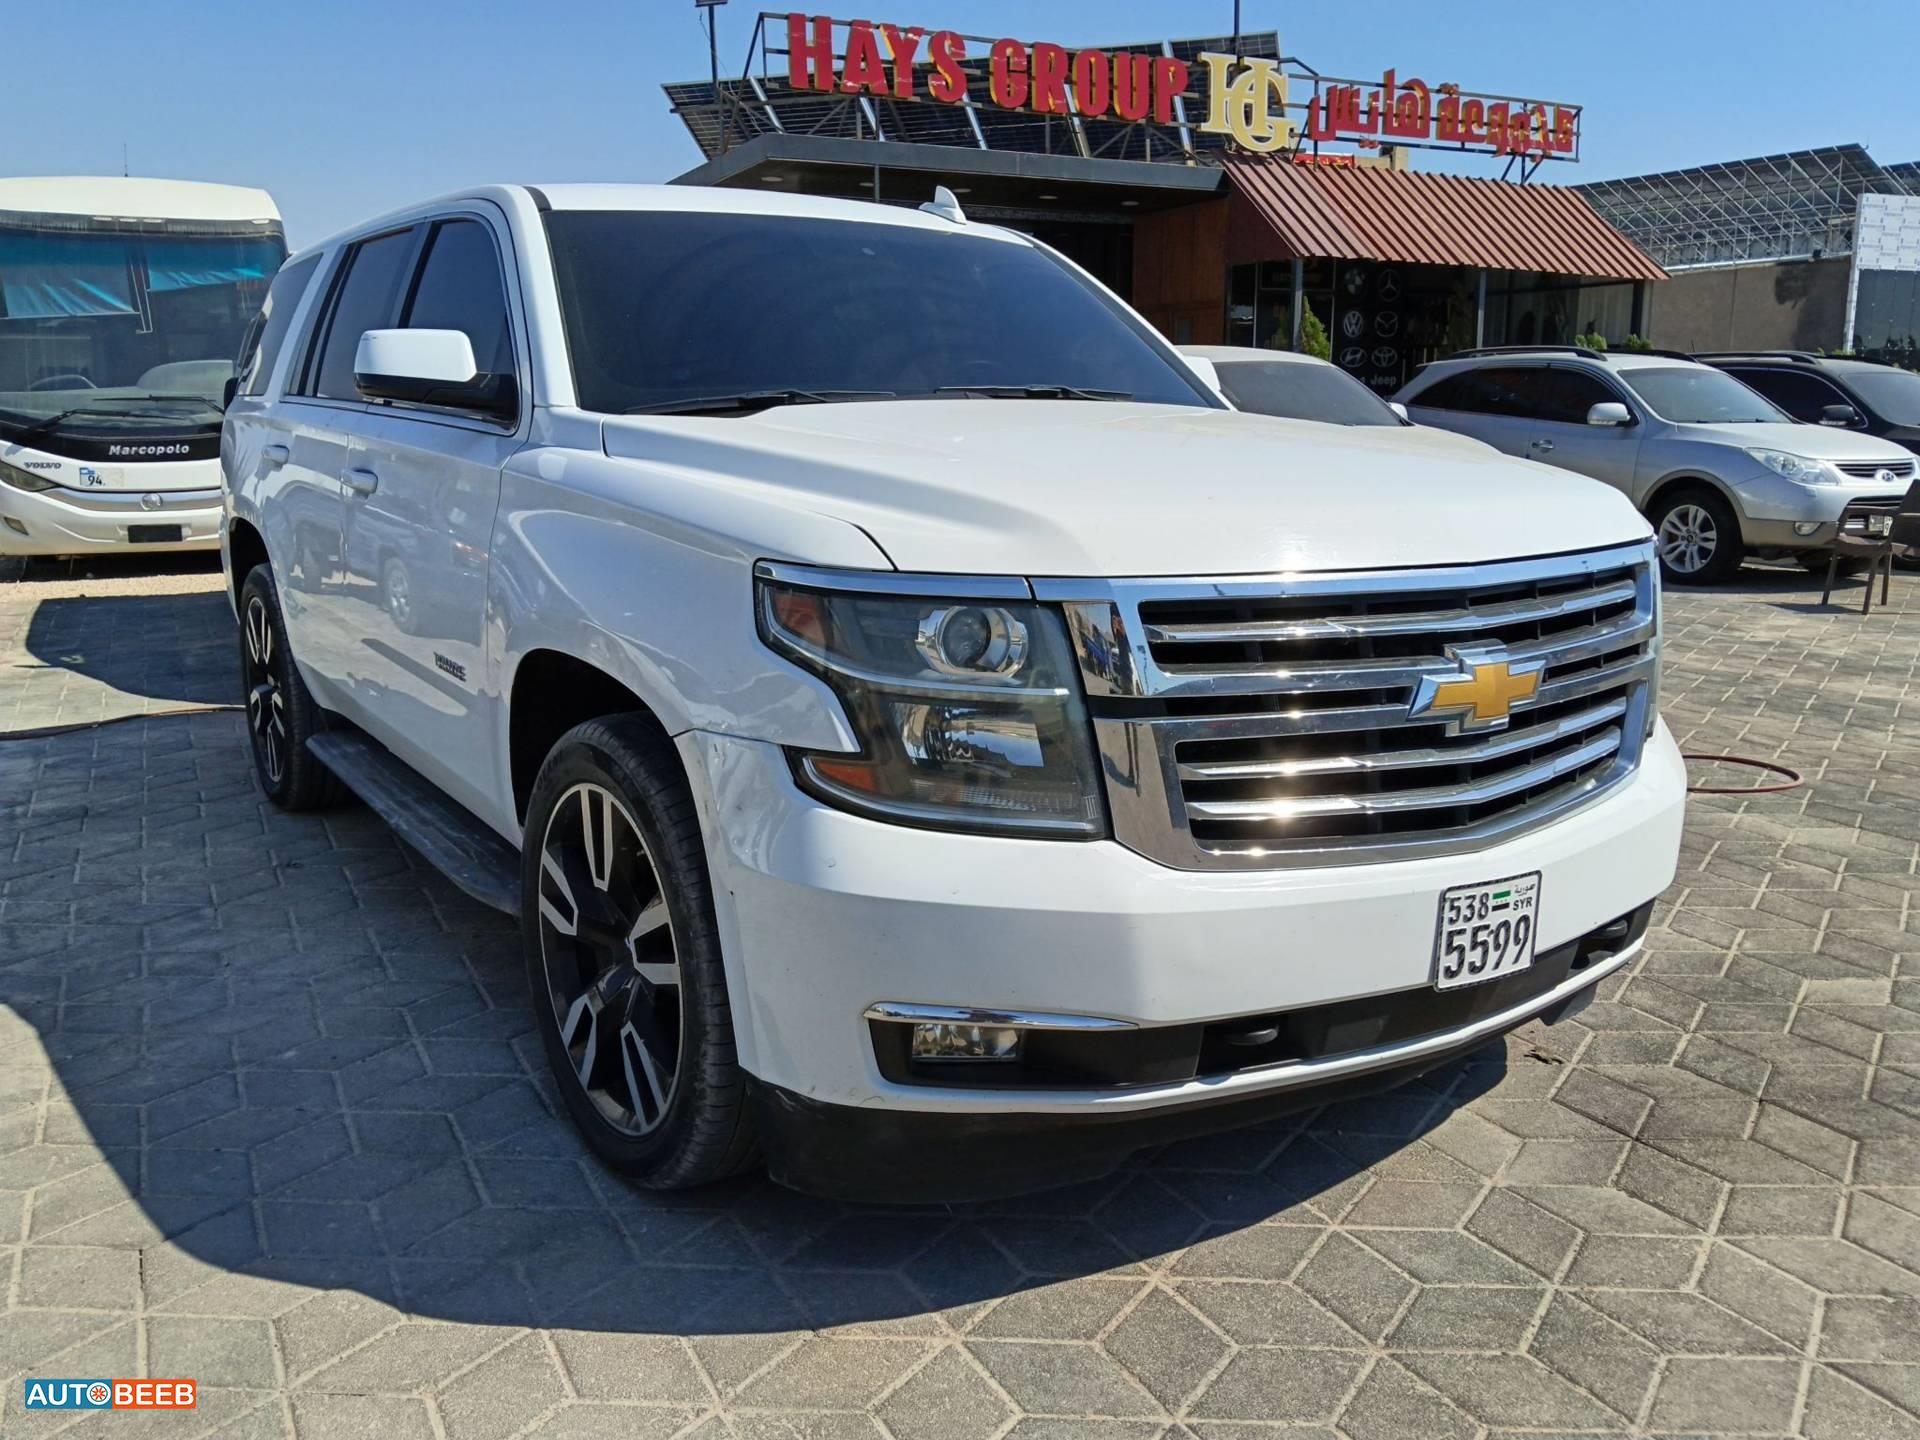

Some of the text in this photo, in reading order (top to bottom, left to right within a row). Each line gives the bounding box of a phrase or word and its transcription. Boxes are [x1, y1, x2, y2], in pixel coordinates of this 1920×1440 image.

[787, 13, 1188, 124] HAYS GROUP
[1307, 68, 1573, 163] مجموعة هايس
[24, 461, 62, 470] VOLVO
[108, 444, 190, 456] Marcopolo
[1444, 892, 1490, 925] 538
[1512, 896, 1533, 911] SYR
[1443, 914, 1531, 980] 5599
